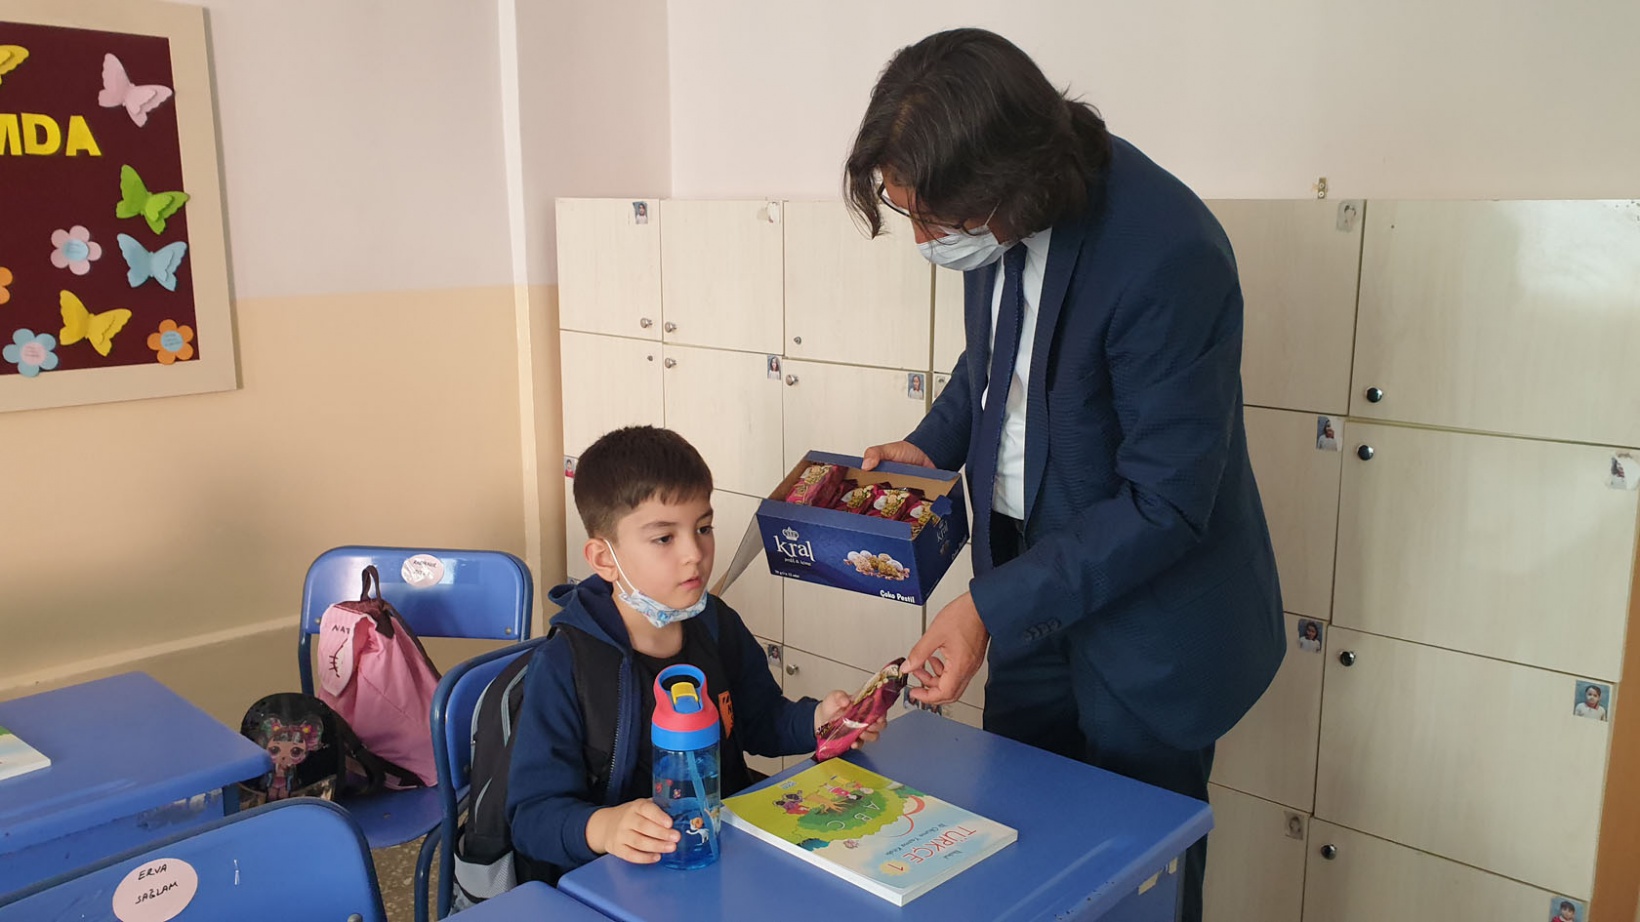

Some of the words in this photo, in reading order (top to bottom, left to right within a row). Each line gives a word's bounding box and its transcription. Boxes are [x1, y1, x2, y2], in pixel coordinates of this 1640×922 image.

[773, 535, 816, 562] kral
[863, 800, 880, 810] A
[854, 812, 873, 822] B
[826, 820, 846, 831] C
[902, 825, 977, 864] TÜRKÇE
[138, 863, 168, 881] ERVA
[887, 862, 904, 872] 1
[134, 881, 179, 905] SAĞLAM
